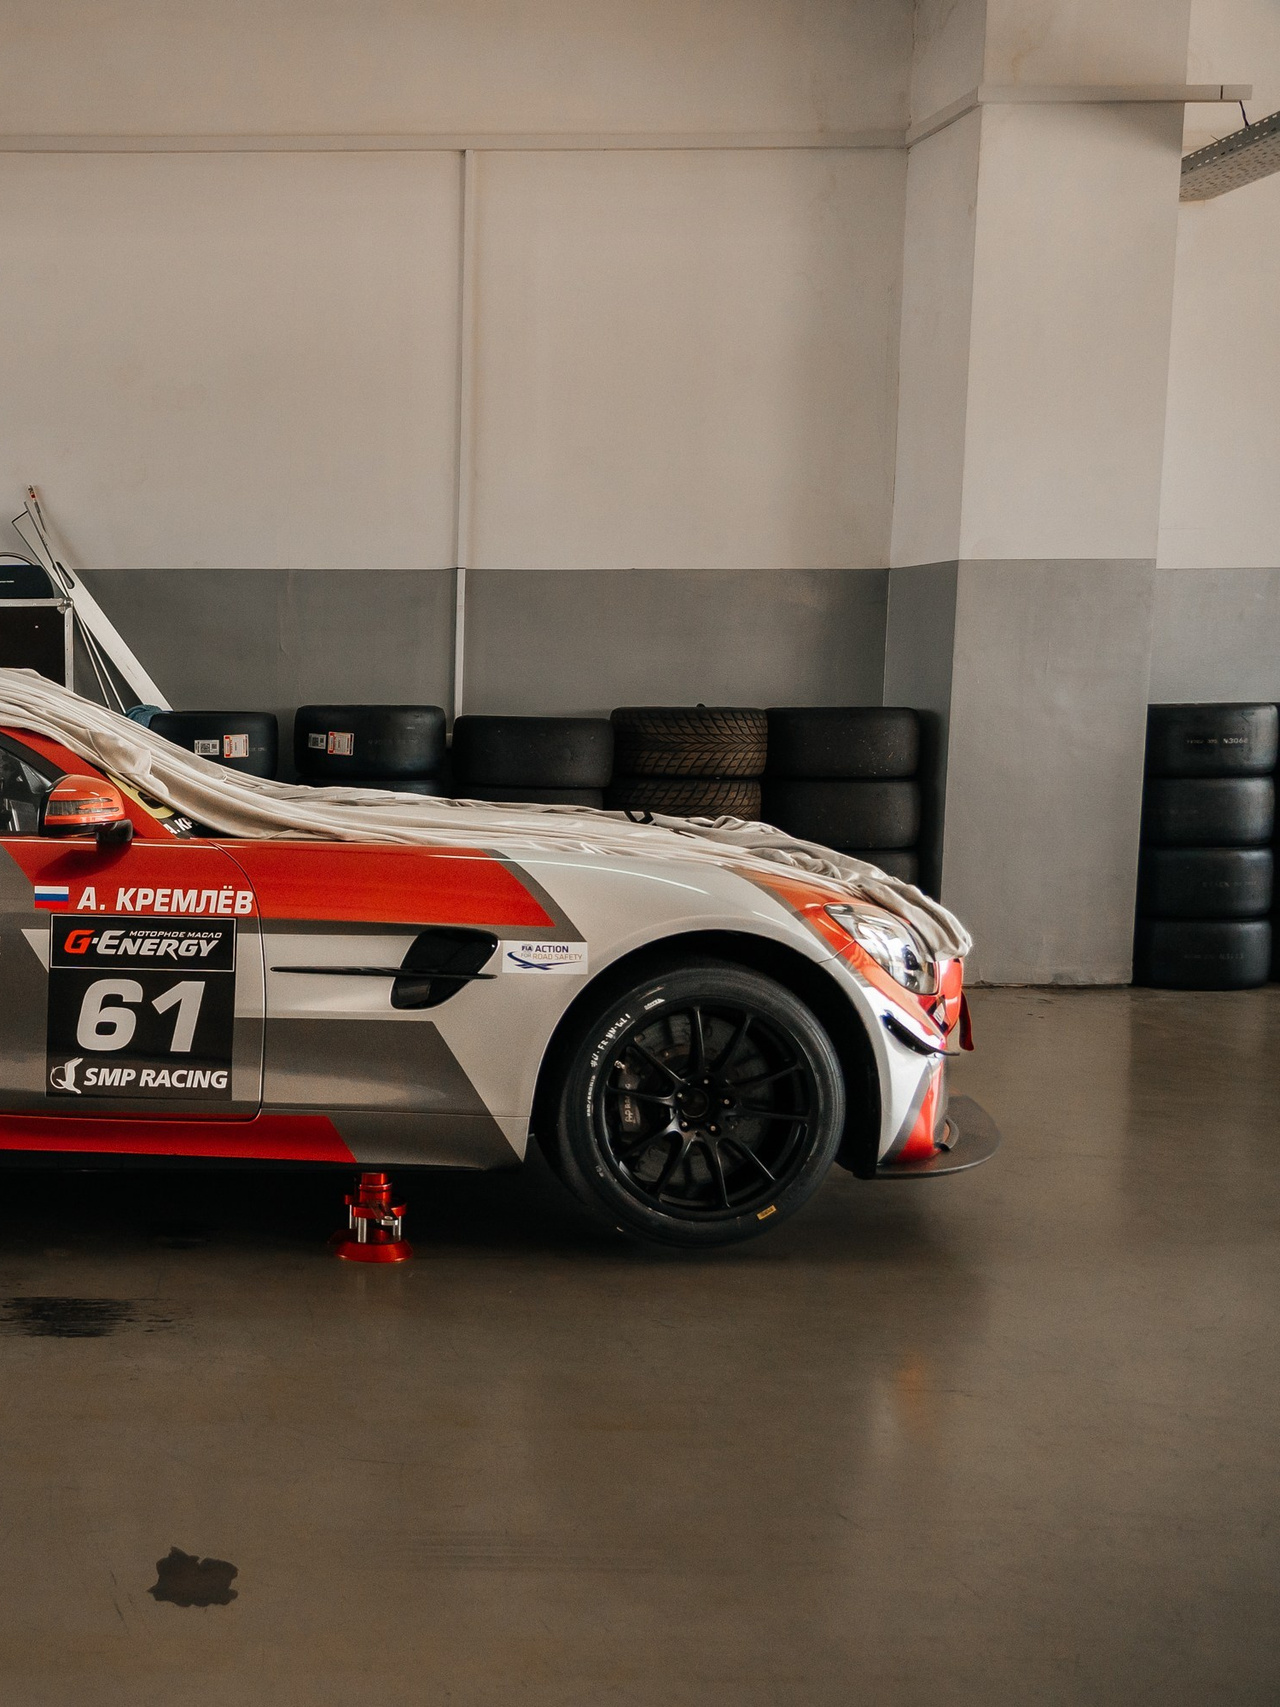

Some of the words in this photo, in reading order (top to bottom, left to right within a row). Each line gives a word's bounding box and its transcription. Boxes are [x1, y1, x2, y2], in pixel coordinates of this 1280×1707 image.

[76, 886, 106, 910] А.
[115, 885, 254, 915] КРЕМЛЁВ
[129, 930, 186, 938] МОТОРНОЕ
[535, 945, 569, 953] ACTION
[76, 978, 206, 1053] 61
[83, 1067, 136, 1087] SMP
[139, 1069, 229, 1089] RACING
